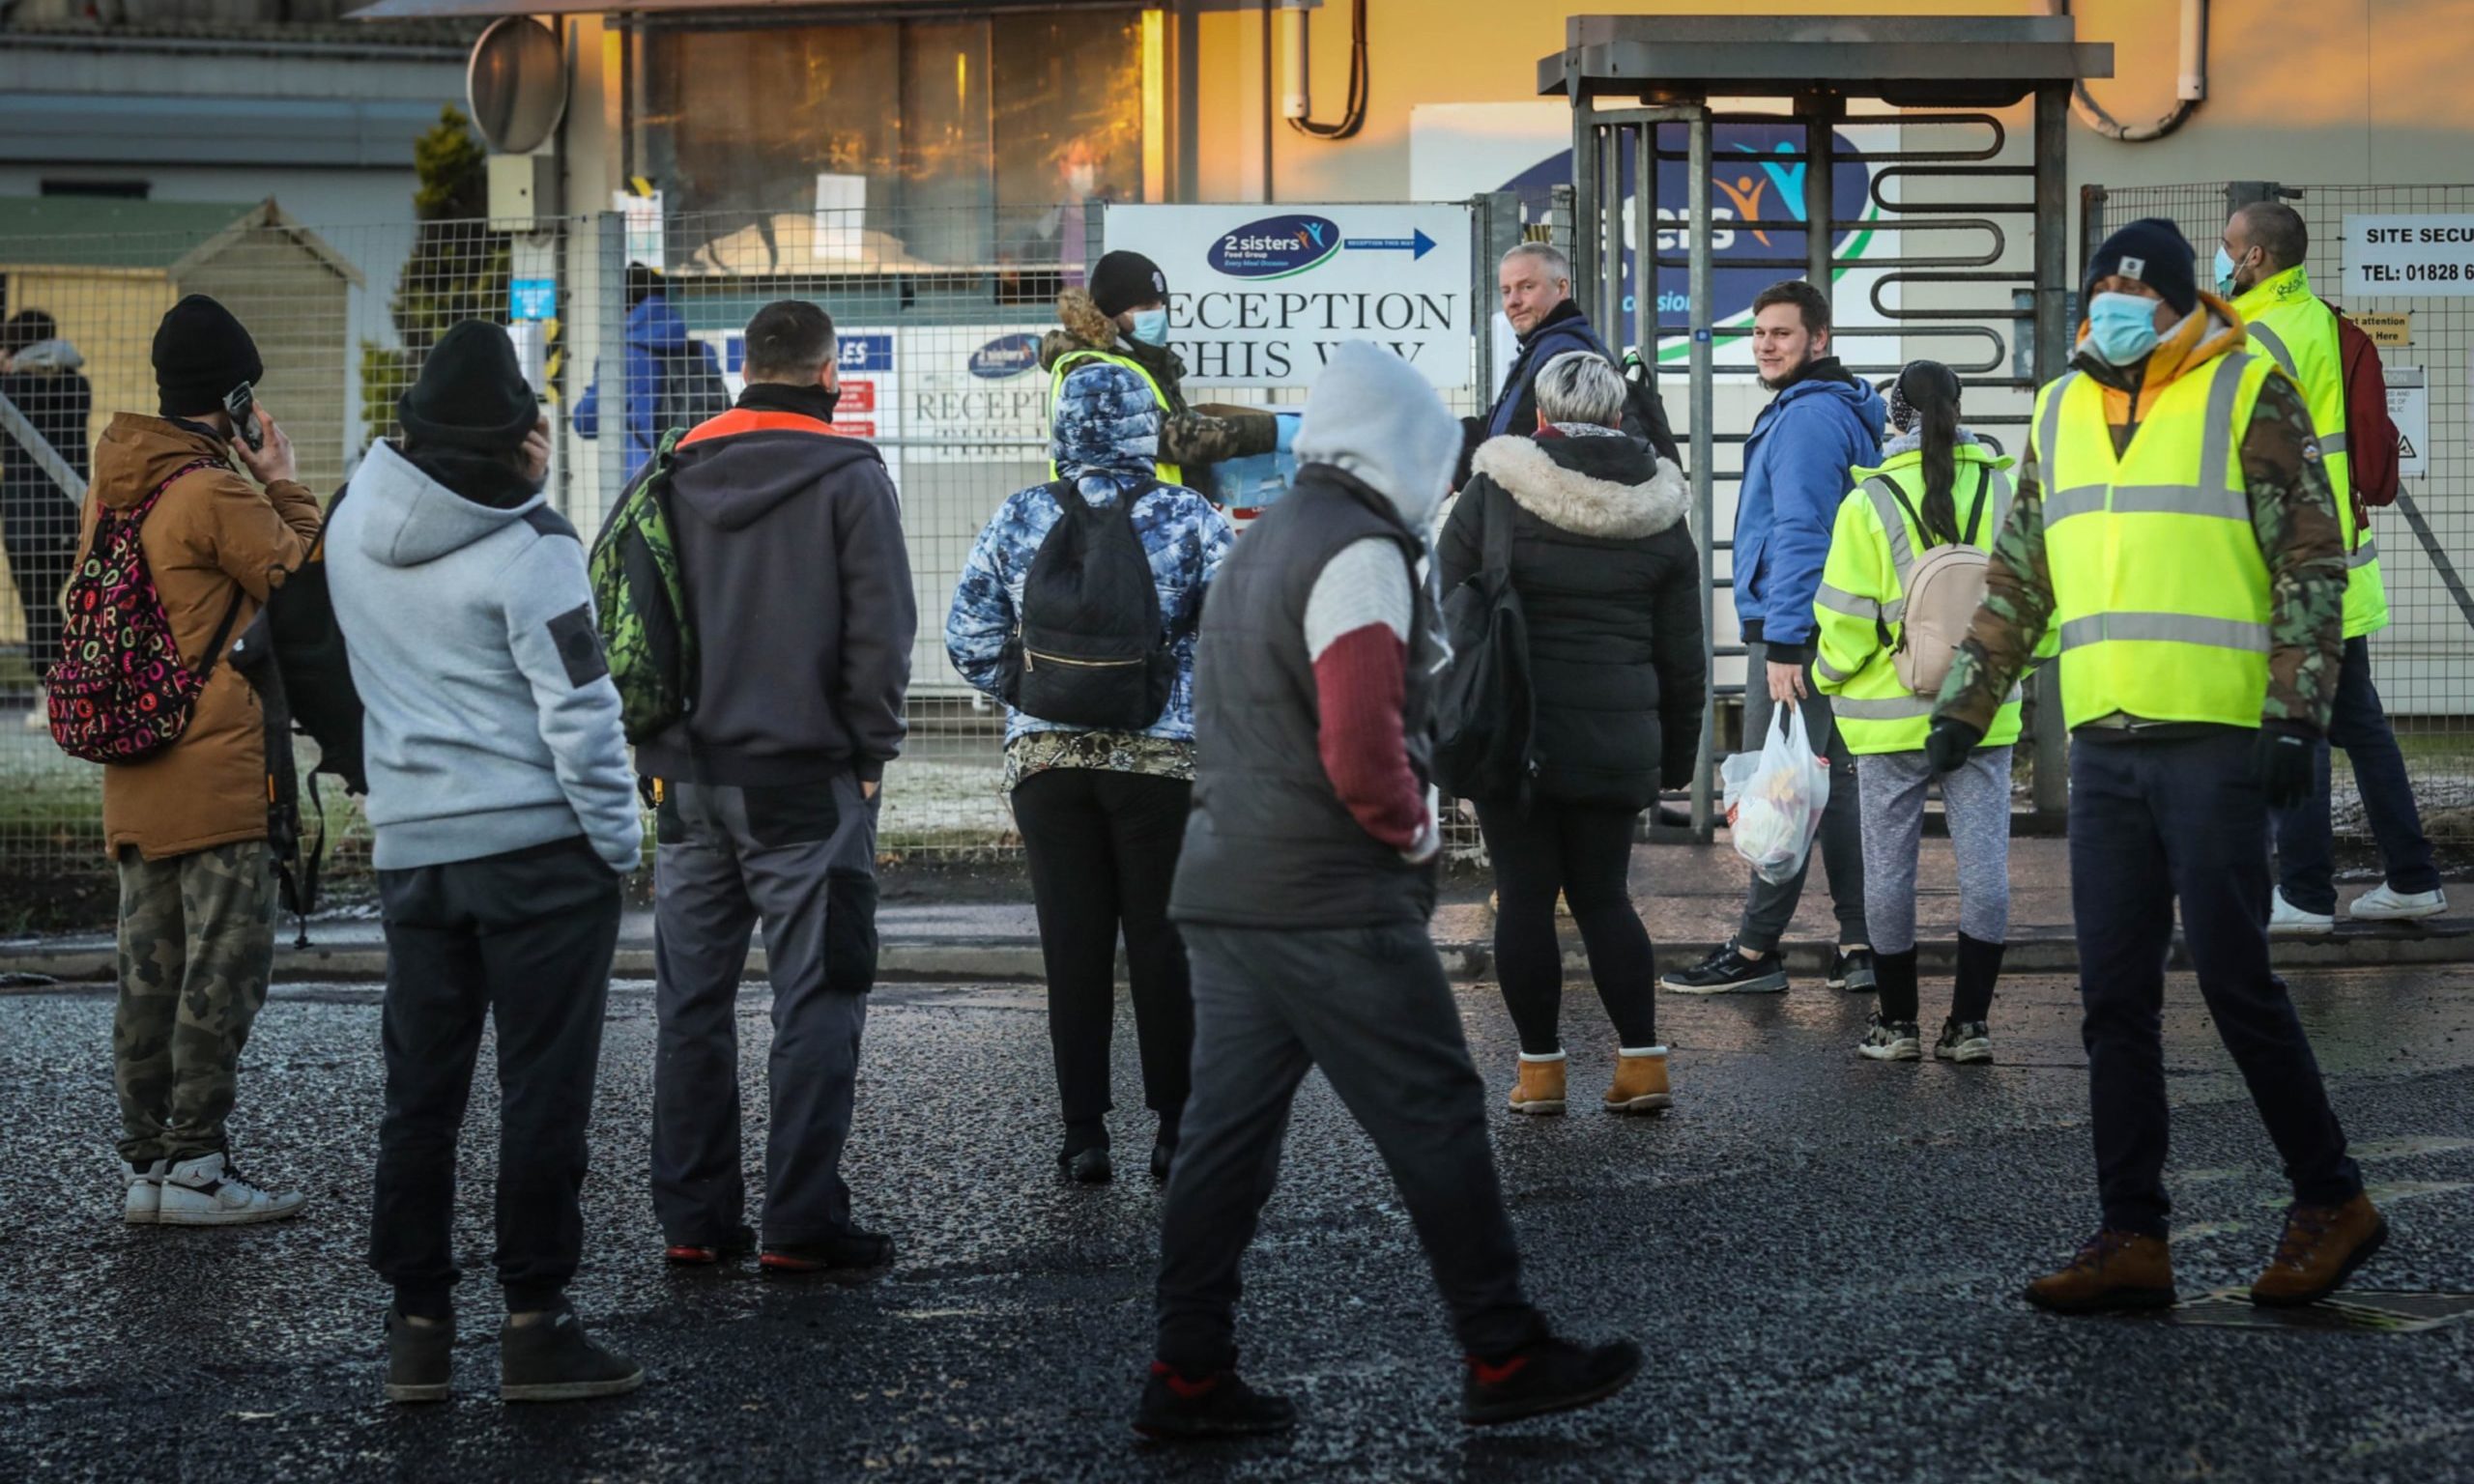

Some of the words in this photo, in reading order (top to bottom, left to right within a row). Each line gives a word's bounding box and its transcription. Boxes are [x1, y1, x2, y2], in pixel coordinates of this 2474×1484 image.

[1224, 235, 1237, 250] 2
[1240, 235, 1300, 250] sisters
[2367, 228, 2413, 243] SITE
[2362, 265, 2401, 281] TEL:
[2406, 264, 2459, 281] 01828
[1166, 293, 1456, 330] ECEPTION
[2375, 331, 2399, 341] Here
